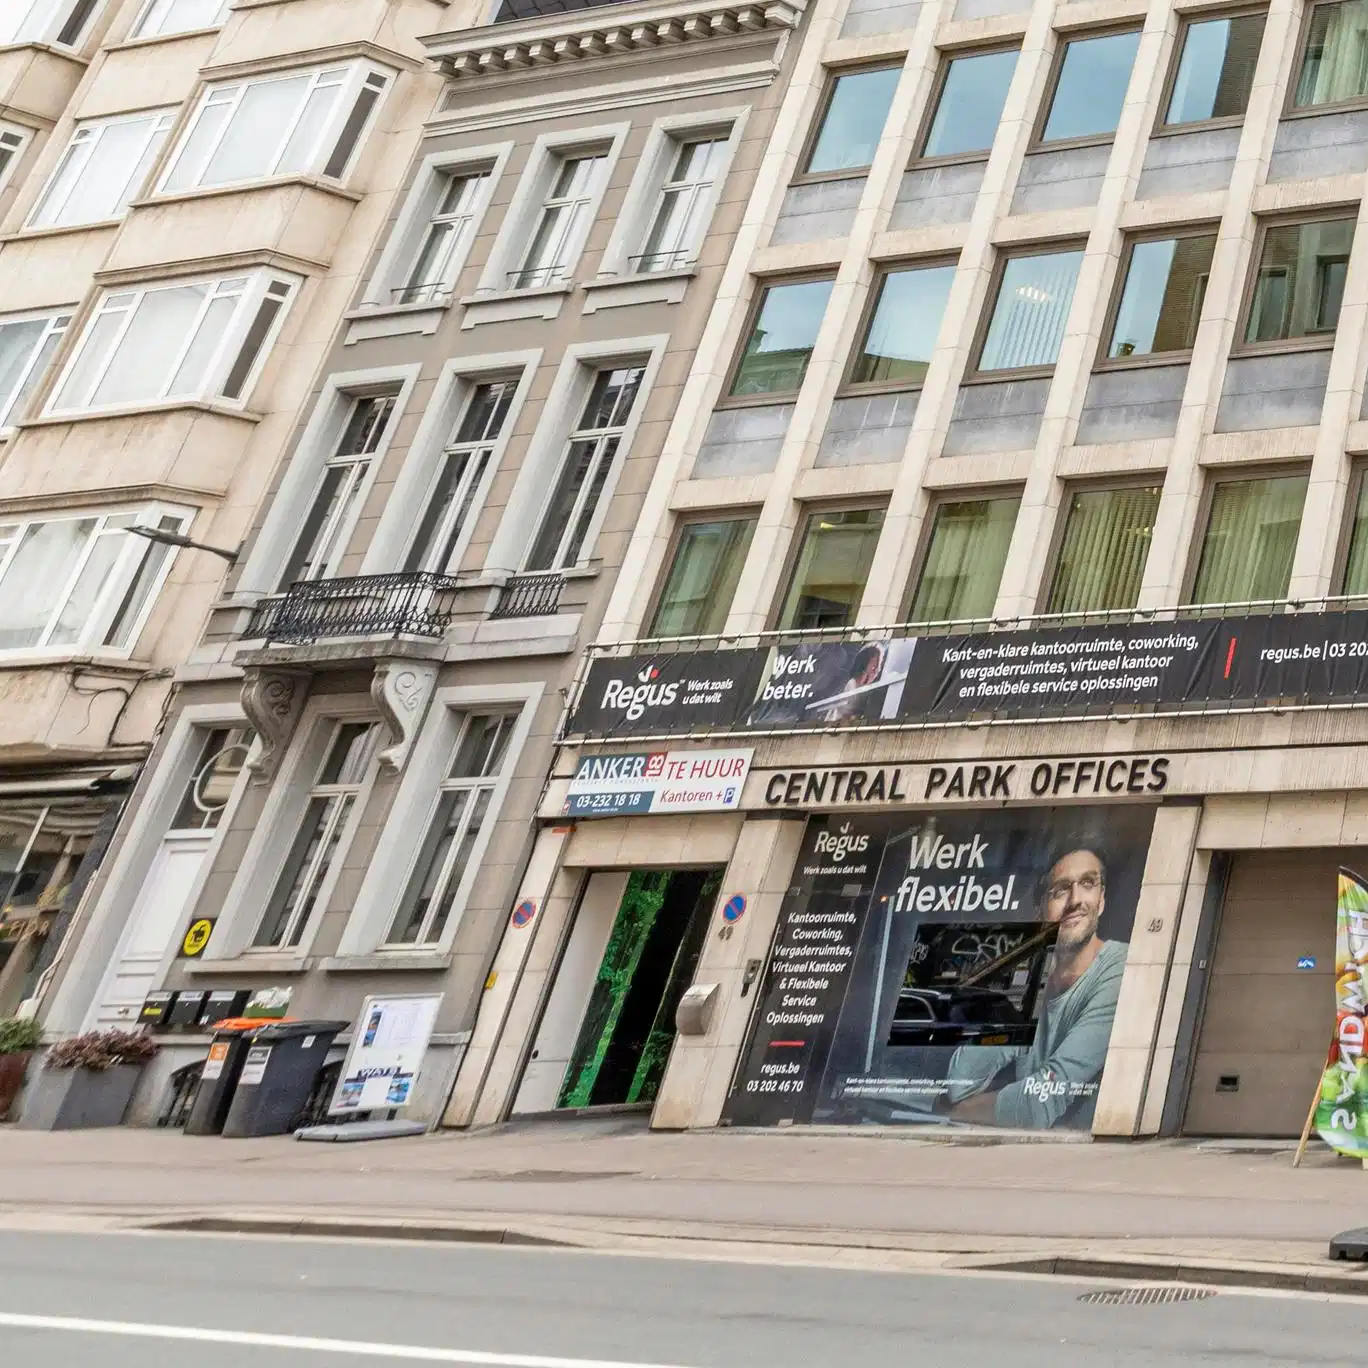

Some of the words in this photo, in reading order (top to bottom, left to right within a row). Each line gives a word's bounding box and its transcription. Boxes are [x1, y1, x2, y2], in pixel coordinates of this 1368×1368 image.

[942, 644, 1029, 663] Kant-en-klare
[1030, 637, 1126, 657] kantoorruimte,
[1128, 633, 1199, 653] coworking,
[1260, 644, 1320, 664] regus.be
[1329, 642, 1345, 658] 03
[771, 654, 818, 680] Werk
[959, 661, 1068, 681] vergaderruimtes,
[1070, 657, 1119, 672] virtueel
[1121, 654, 1173, 669] kantoor
[687, 680, 711, 692] Werk
[711, 679, 733, 690] zoals
[762, 681, 814, 701] beter.
[959, 686, 975, 698] en
[977, 680, 1030, 697] flexibele
[1031, 678, 1078, 693] service
[1080, 674, 1158, 694] oplossingen
[600, 680, 679, 721] Regus
[682, 695, 689, 705] u
[688, 694, 704, 704] dat
[703, 692, 722, 704] wilt
[576, 756, 645, 780] ANKER
[667, 760, 687, 781] TE
[690, 758, 746, 780] HUUR
[765, 767, 907, 805] CENTRAL
[925, 763, 1017, 799] PARK
[1030, 757, 1171, 795] OFFICES
[576, 794, 612, 808] 03-232
[614, 793, 627, 806] 18
[628, 793, 641, 806] 18
[660, 788, 713, 804] Kantoren
[814, 830, 870, 862] Regus
[909, 834, 989, 871] Werk
[803, 865, 822, 875] Werk
[822, 865, 838, 875] zoals
[843, 865, 855, 875] dat
[854, 864, 867, 875] wilt
[894, 875, 1020, 913] flexibel.
[788, 911, 857, 924] Kantoorruimte,
[792, 928, 844, 941] Coworking,
[774, 944, 853, 958] Vergaderruimtes,
[772, 961, 808, 973] Virtueel
[808, 961, 846, 973] Kantoor
[779, 978, 787, 989] &
[787, 977, 829, 989] Flexibele
[782, 995, 817, 1006] Service
[766, 1011, 824, 1026] Oplossingen
[760, 1062, 800, 1075] regus.be
[747, 1081, 759, 1093] 03
[759, 1081, 777, 1093] 202
[778, 1080, 790, 1092] 46
[791, 1080, 804, 1092] 70
[1024, 1077, 1067, 1103] Regus
